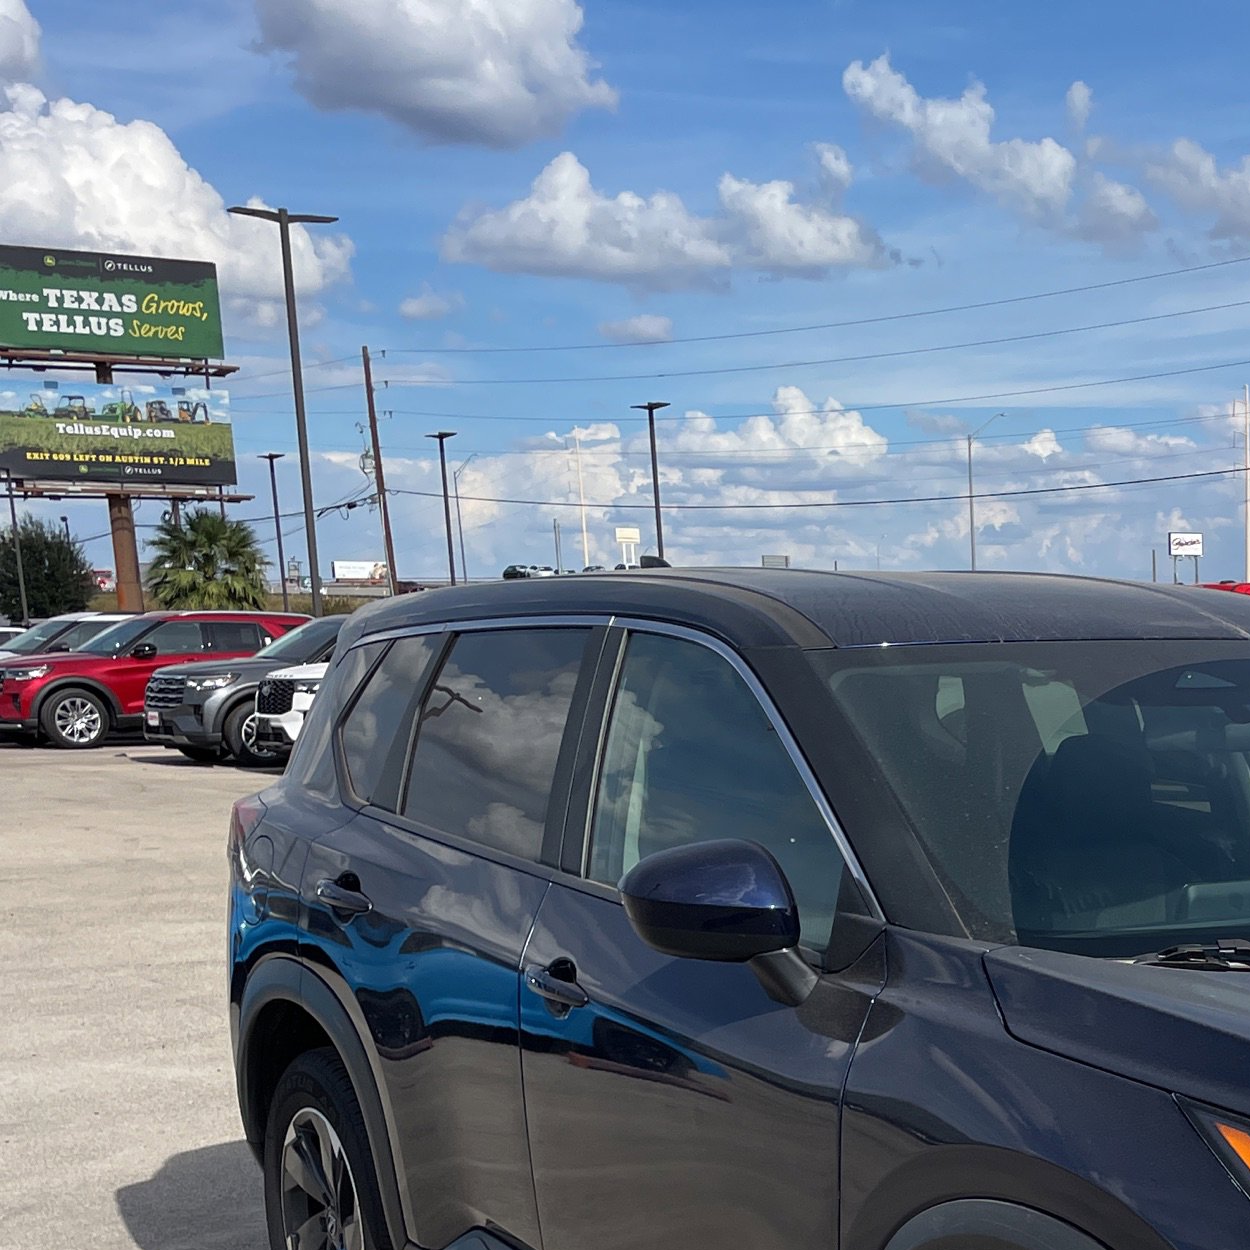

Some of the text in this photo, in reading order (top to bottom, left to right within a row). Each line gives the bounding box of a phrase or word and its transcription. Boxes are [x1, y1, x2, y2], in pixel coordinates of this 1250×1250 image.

[116, 263, 153, 273] TELLUS
[0, 288, 208, 321] Where TEXAS Grows,
[22, 312, 125, 337] TELLUS
[55, 423, 175, 439] TellusEquip.com
[26, 452, 50, 460] EXIT
[52, 453, 71, 461] 609
[73, 454, 97, 462] LEFT
[99, 454, 113, 463] ON
[115, 455, 151, 464] AUSTIN
[169, 457, 184, 467] 1/2
[186, 458, 211, 466] MILE
